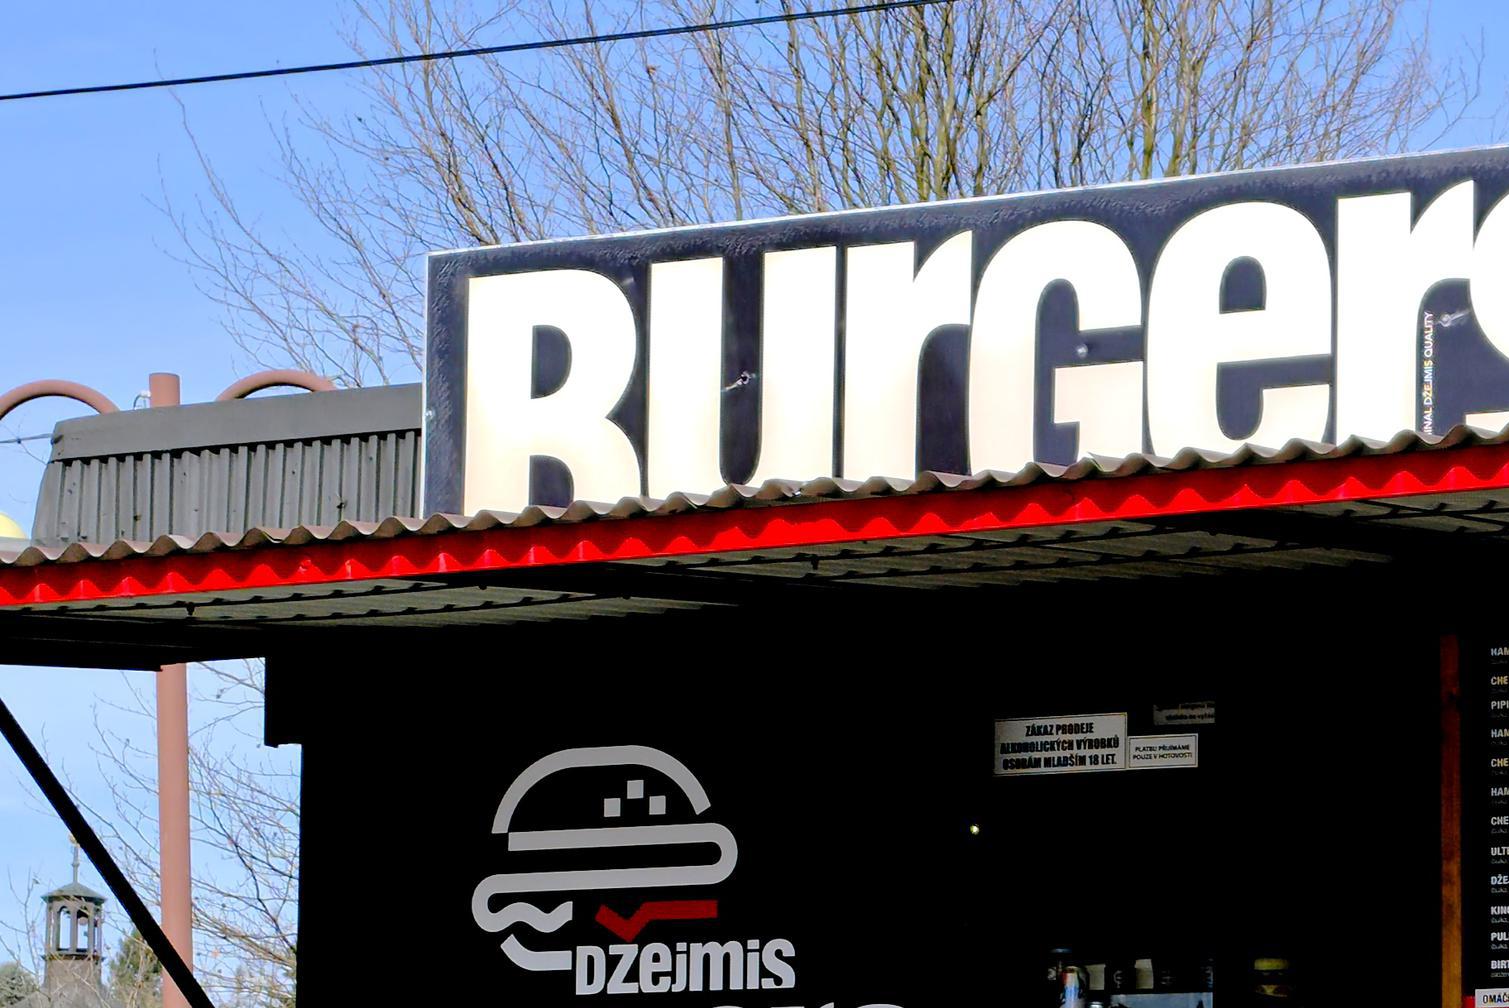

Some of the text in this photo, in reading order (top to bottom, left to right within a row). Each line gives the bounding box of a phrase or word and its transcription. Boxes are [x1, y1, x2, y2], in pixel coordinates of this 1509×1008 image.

[1423, 311, 1434, 357] QUALITY
[1026, 723, 1094, 736] ZÁKAZ PRODEJE
[1088, 755, 1099, 765] 18
